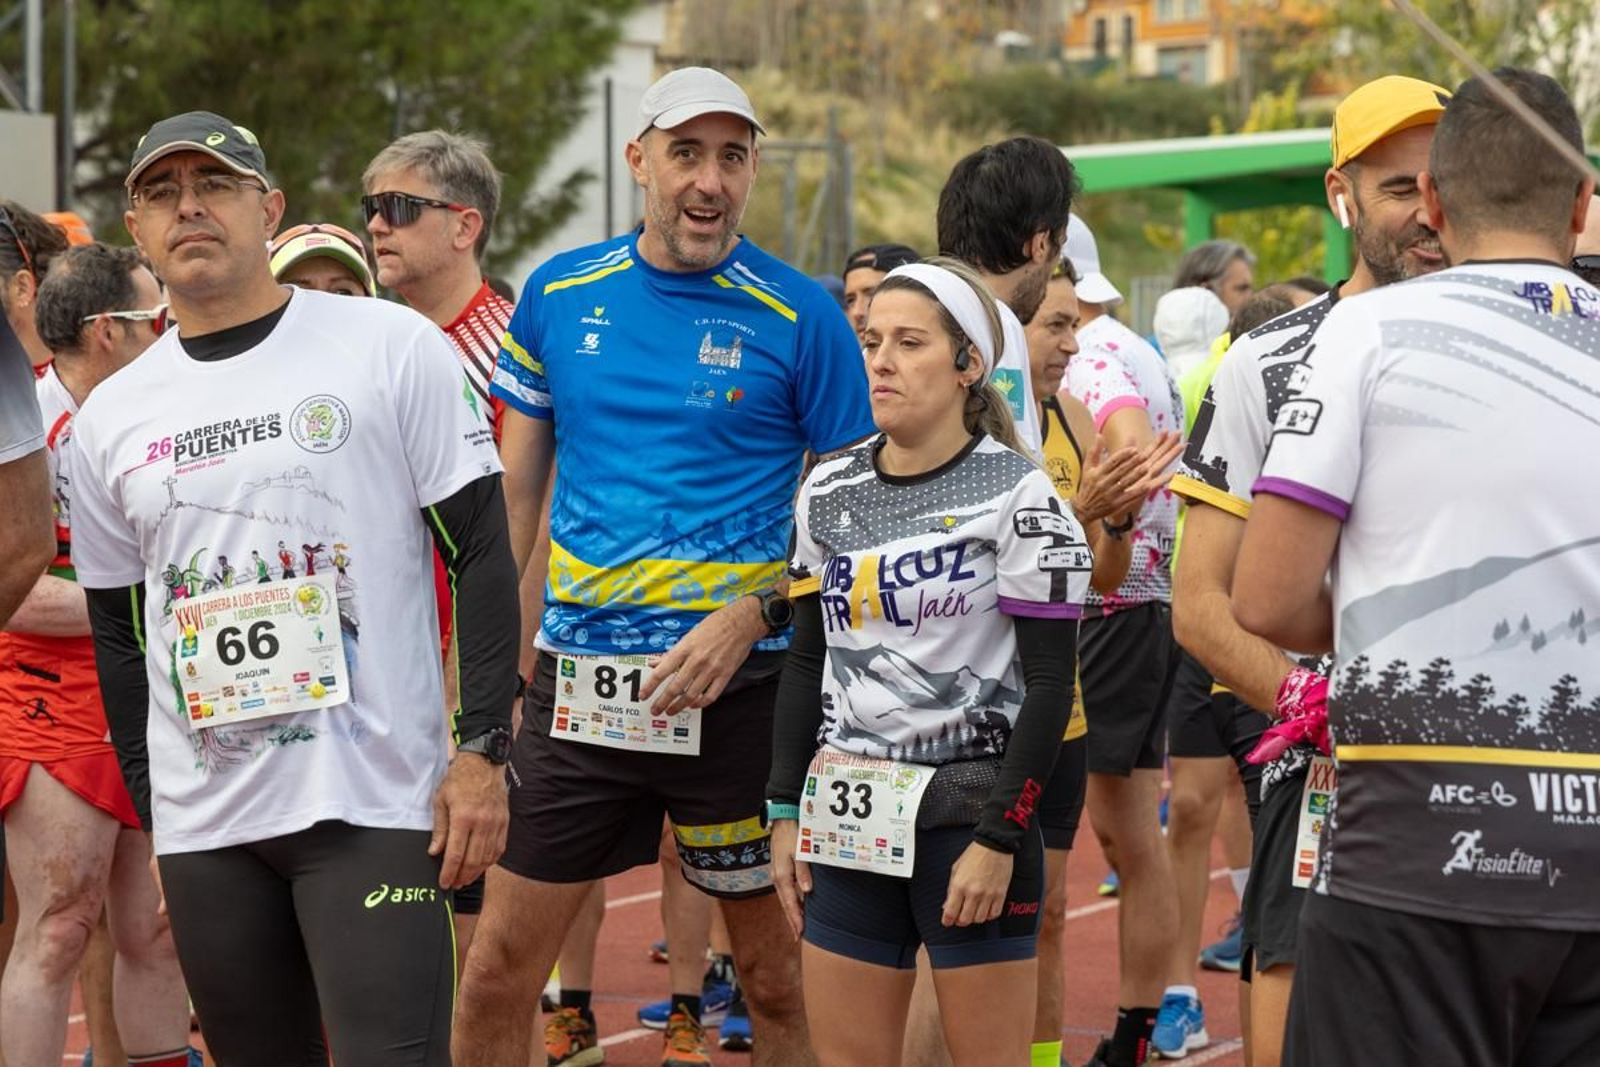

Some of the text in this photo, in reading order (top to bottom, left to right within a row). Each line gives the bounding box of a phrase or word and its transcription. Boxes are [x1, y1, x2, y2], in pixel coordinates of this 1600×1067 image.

[174, 421, 282, 462] PUENTES
[175, 413, 281, 444] CARRERA DE LOS
[146, 437, 172, 462] 26
[175, 587, 291, 635] XXVI CARRERA A LOS PUENTES
[238, 604, 274, 621] DICIEMBRE
[274, 602, 293, 616] 2024
[912, 587, 973, 636] Jaén
[216, 620, 280, 666] 66
[234, 667, 271, 681] JOAQUIN
[594, 665, 642, 703] 81
[598, 704, 624, 714] CARLOS
[829, 780, 872, 819] 33
[1429, 784, 1475, 804] AFC
[1528, 772, 1600, 814] VICT
